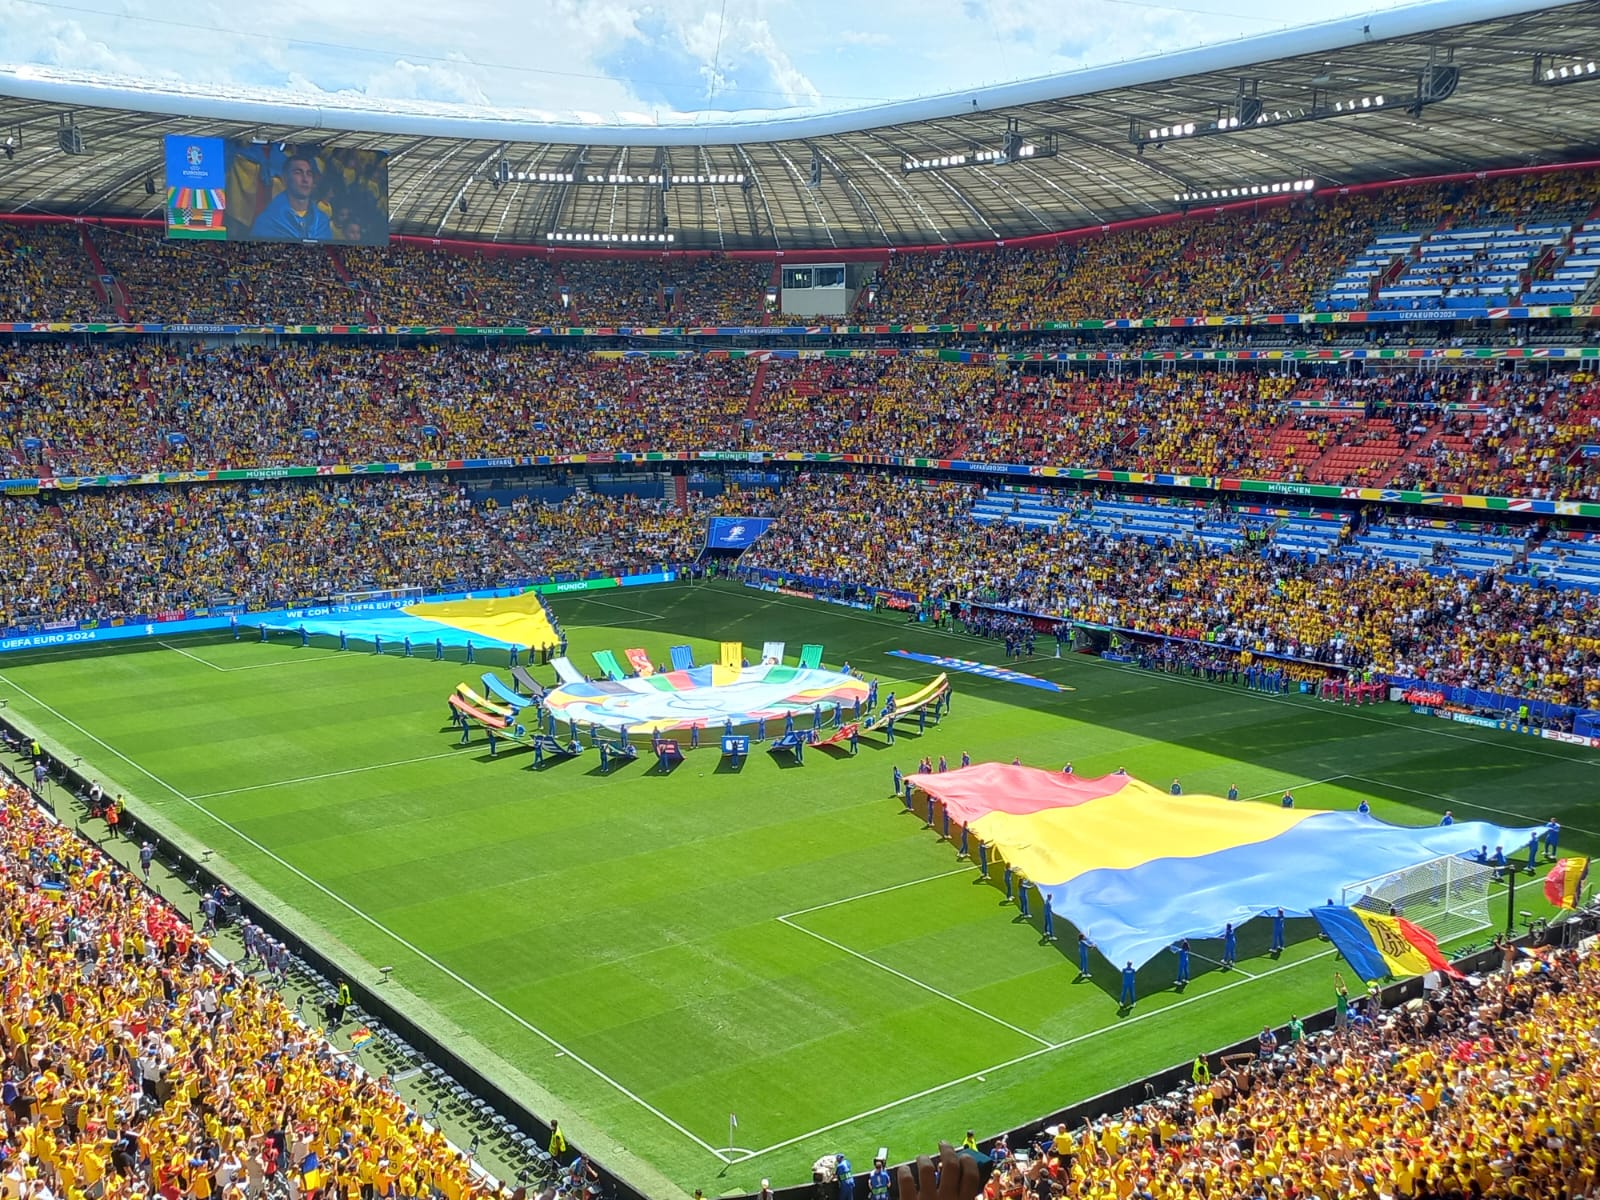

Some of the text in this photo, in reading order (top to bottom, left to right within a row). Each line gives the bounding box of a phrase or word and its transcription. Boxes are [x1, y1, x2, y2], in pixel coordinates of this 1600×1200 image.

[718, 452, 748, 460] MUNICH
[246, 468, 289, 477] MÜNCHEN
[556, 582, 588, 591] MUNICH
[286, 608, 335, 618] WECOM
[2, 631, 96, 649] UEFA EURO 2024
[1453, 713, 1498, 729] Hisense
